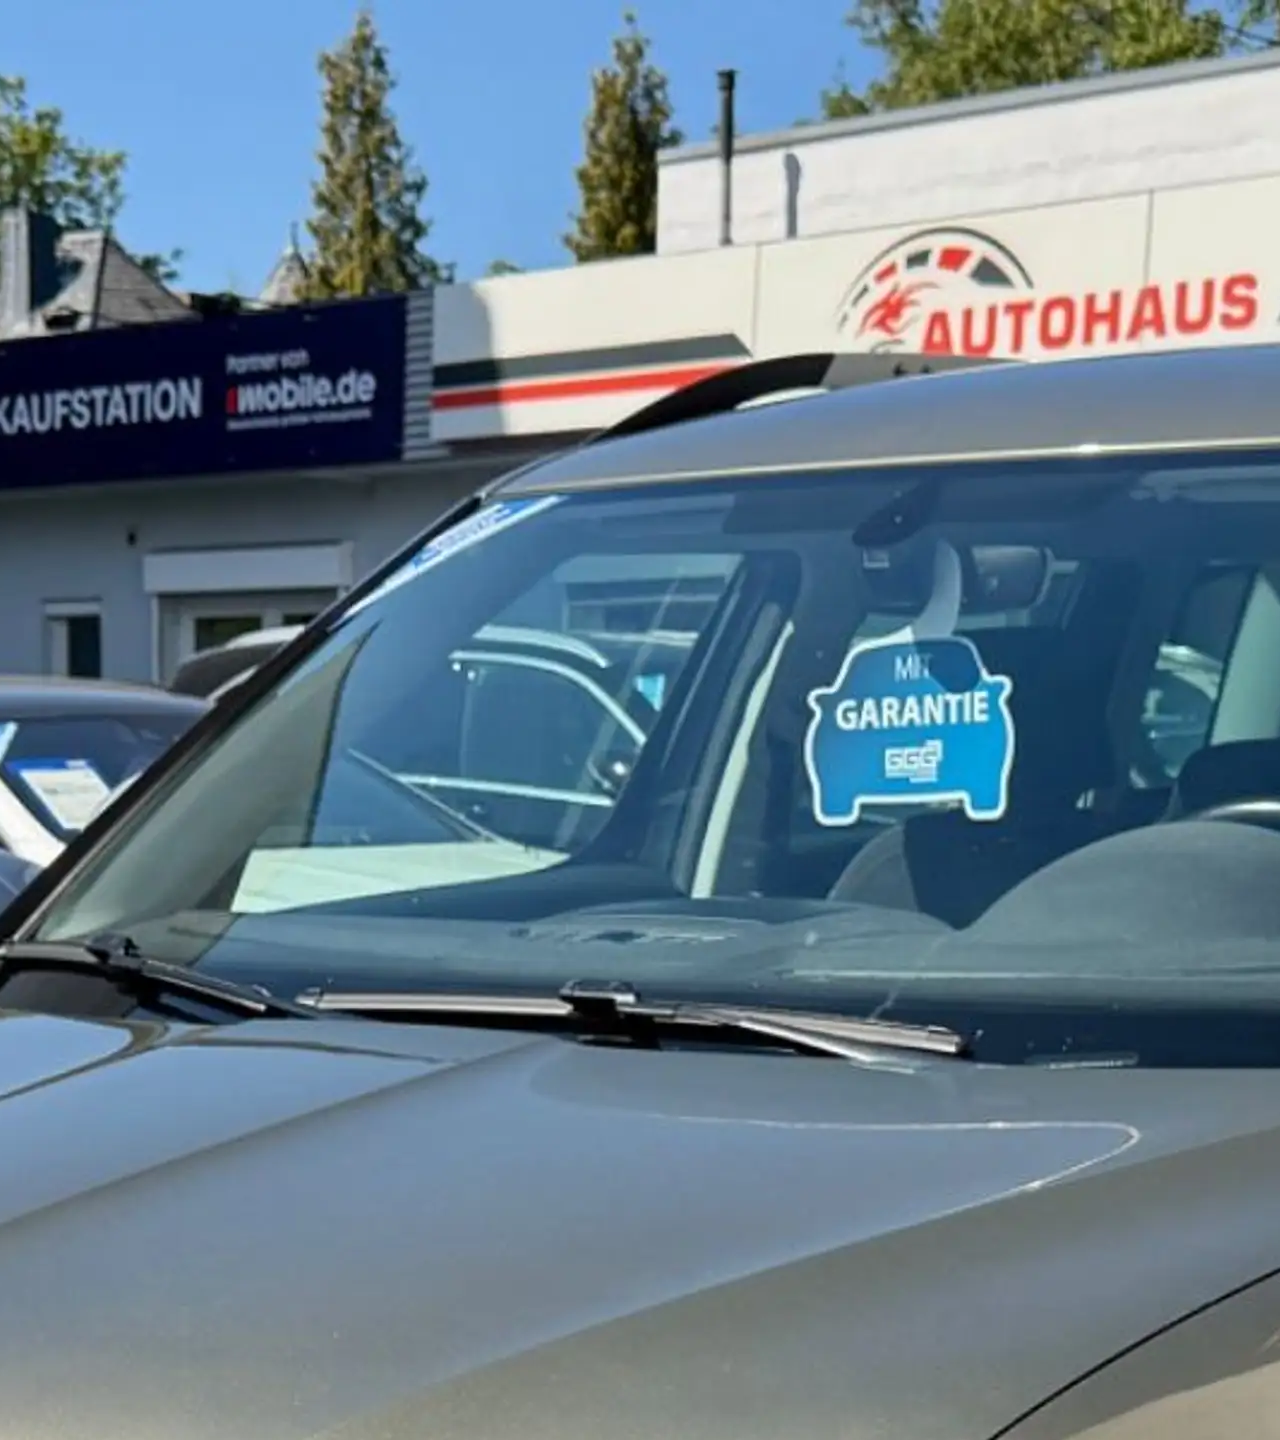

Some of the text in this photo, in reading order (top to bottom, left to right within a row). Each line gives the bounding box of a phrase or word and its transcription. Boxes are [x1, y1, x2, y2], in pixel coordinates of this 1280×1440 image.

[922, 273, 1259, 358] AUTOHAUS
[227, 367, 377, 415] mobile.de
[835, 691, 990, 731] GARANTIE
